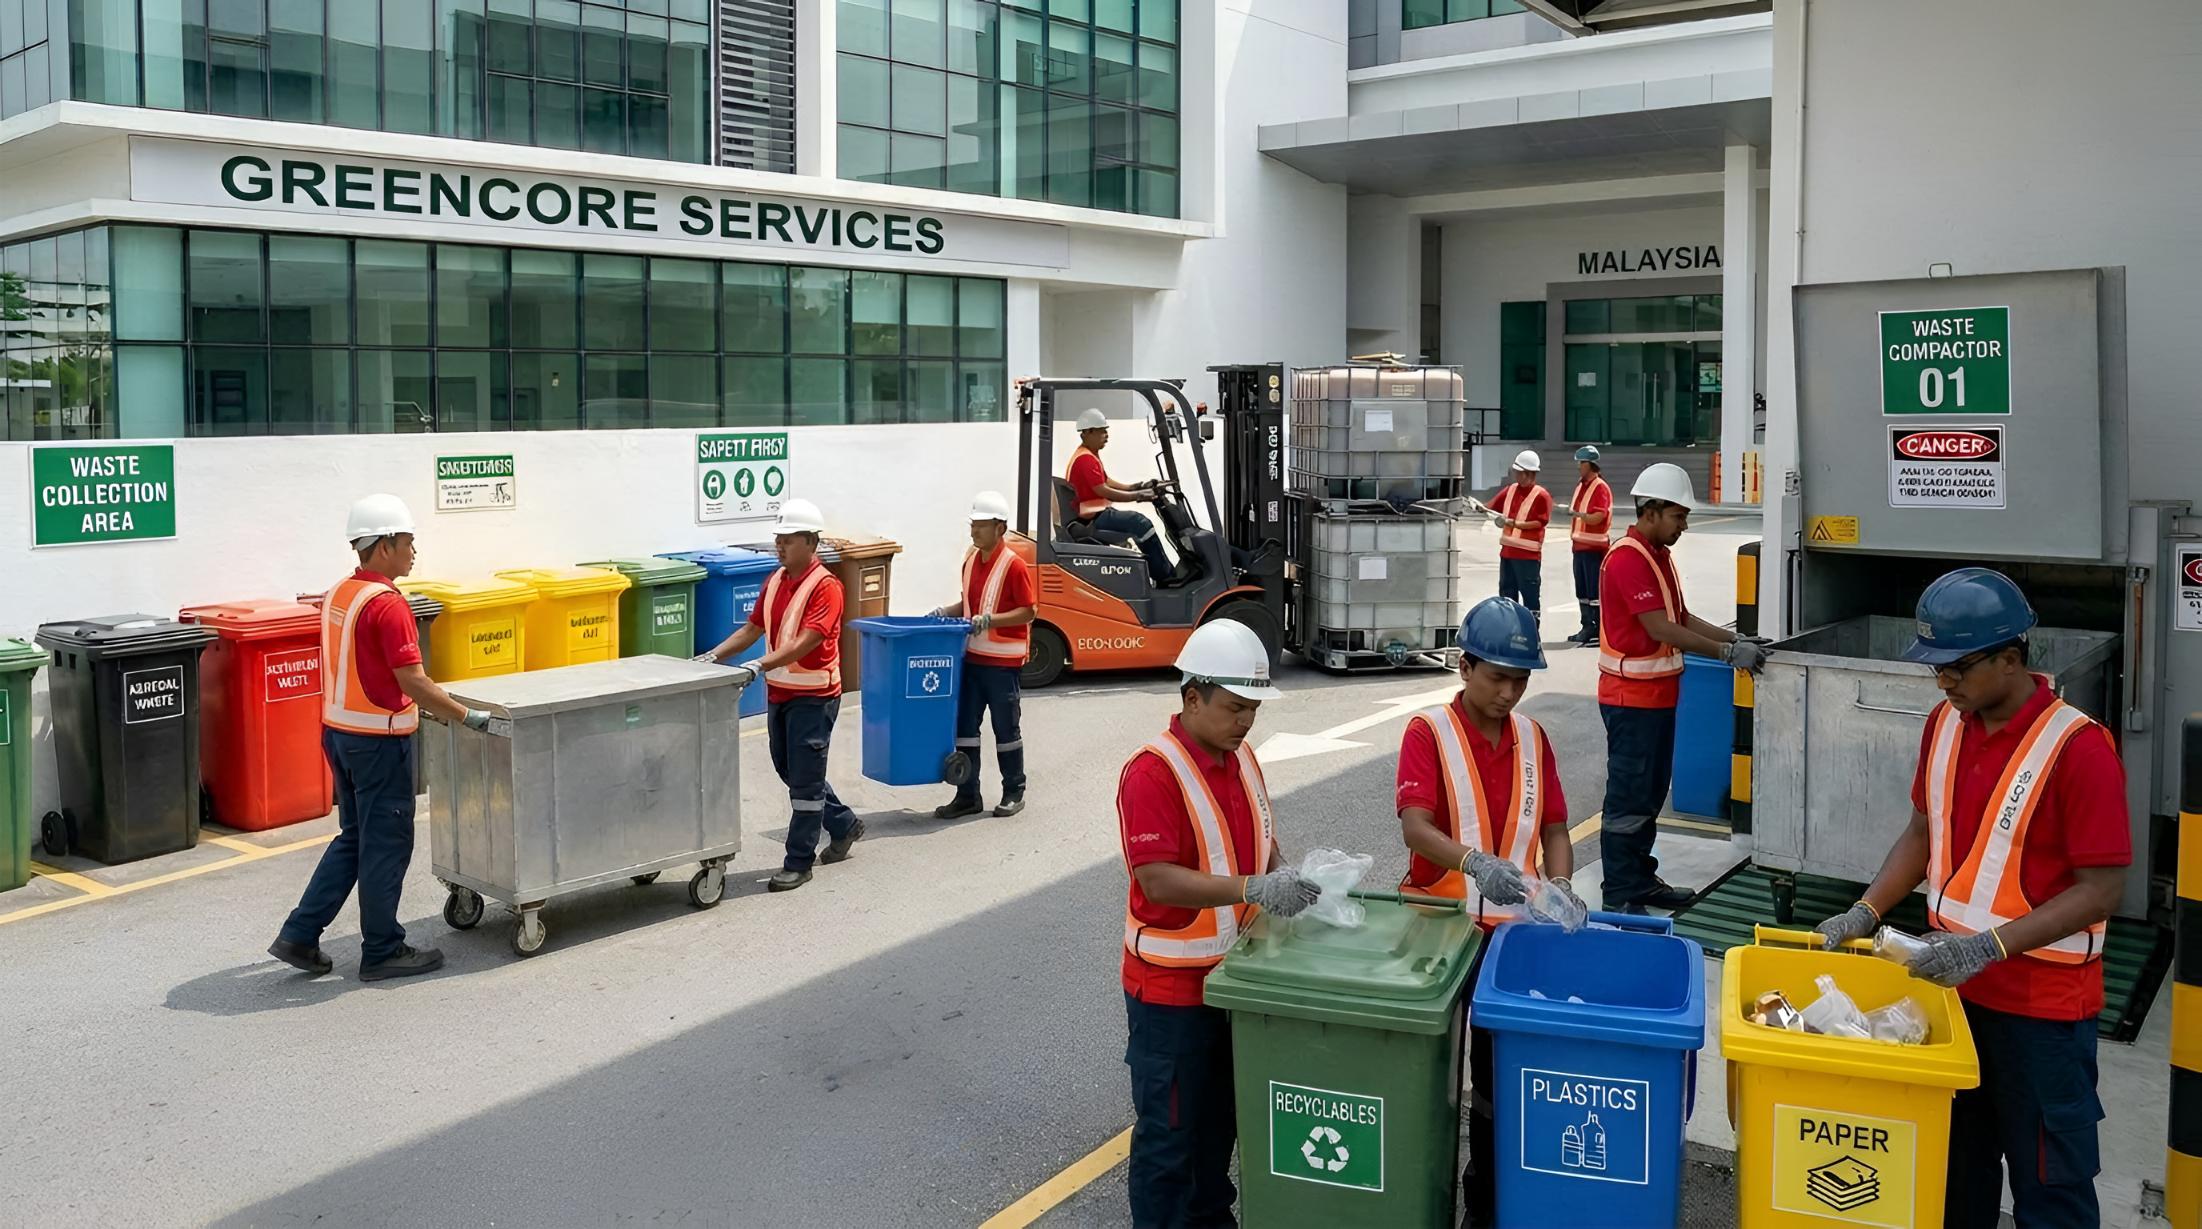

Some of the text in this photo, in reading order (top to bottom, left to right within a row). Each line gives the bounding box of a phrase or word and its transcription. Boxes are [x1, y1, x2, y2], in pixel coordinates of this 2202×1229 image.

[220, 155, 945, 254] GREENCORE SERVICES
[1578, 245, 1721, 274] MALAYSIA
[1912, 318, 1974, 337] WASTE
[1889, 340, 2001, 361] COMPACTOR
[1919, 366, 1965, 408] 01
[70, 455, 140, 478] WASTE
[42, 481, 167, 507] COLLECTION
[81, 511, 134, 533] AREA
[1276, 1091, 1377, 1125] RECYCLABLES
[1533, 1078, 1636, 1110] PLASTICS
[1800, 1118, 1889, 1153] PAPER
